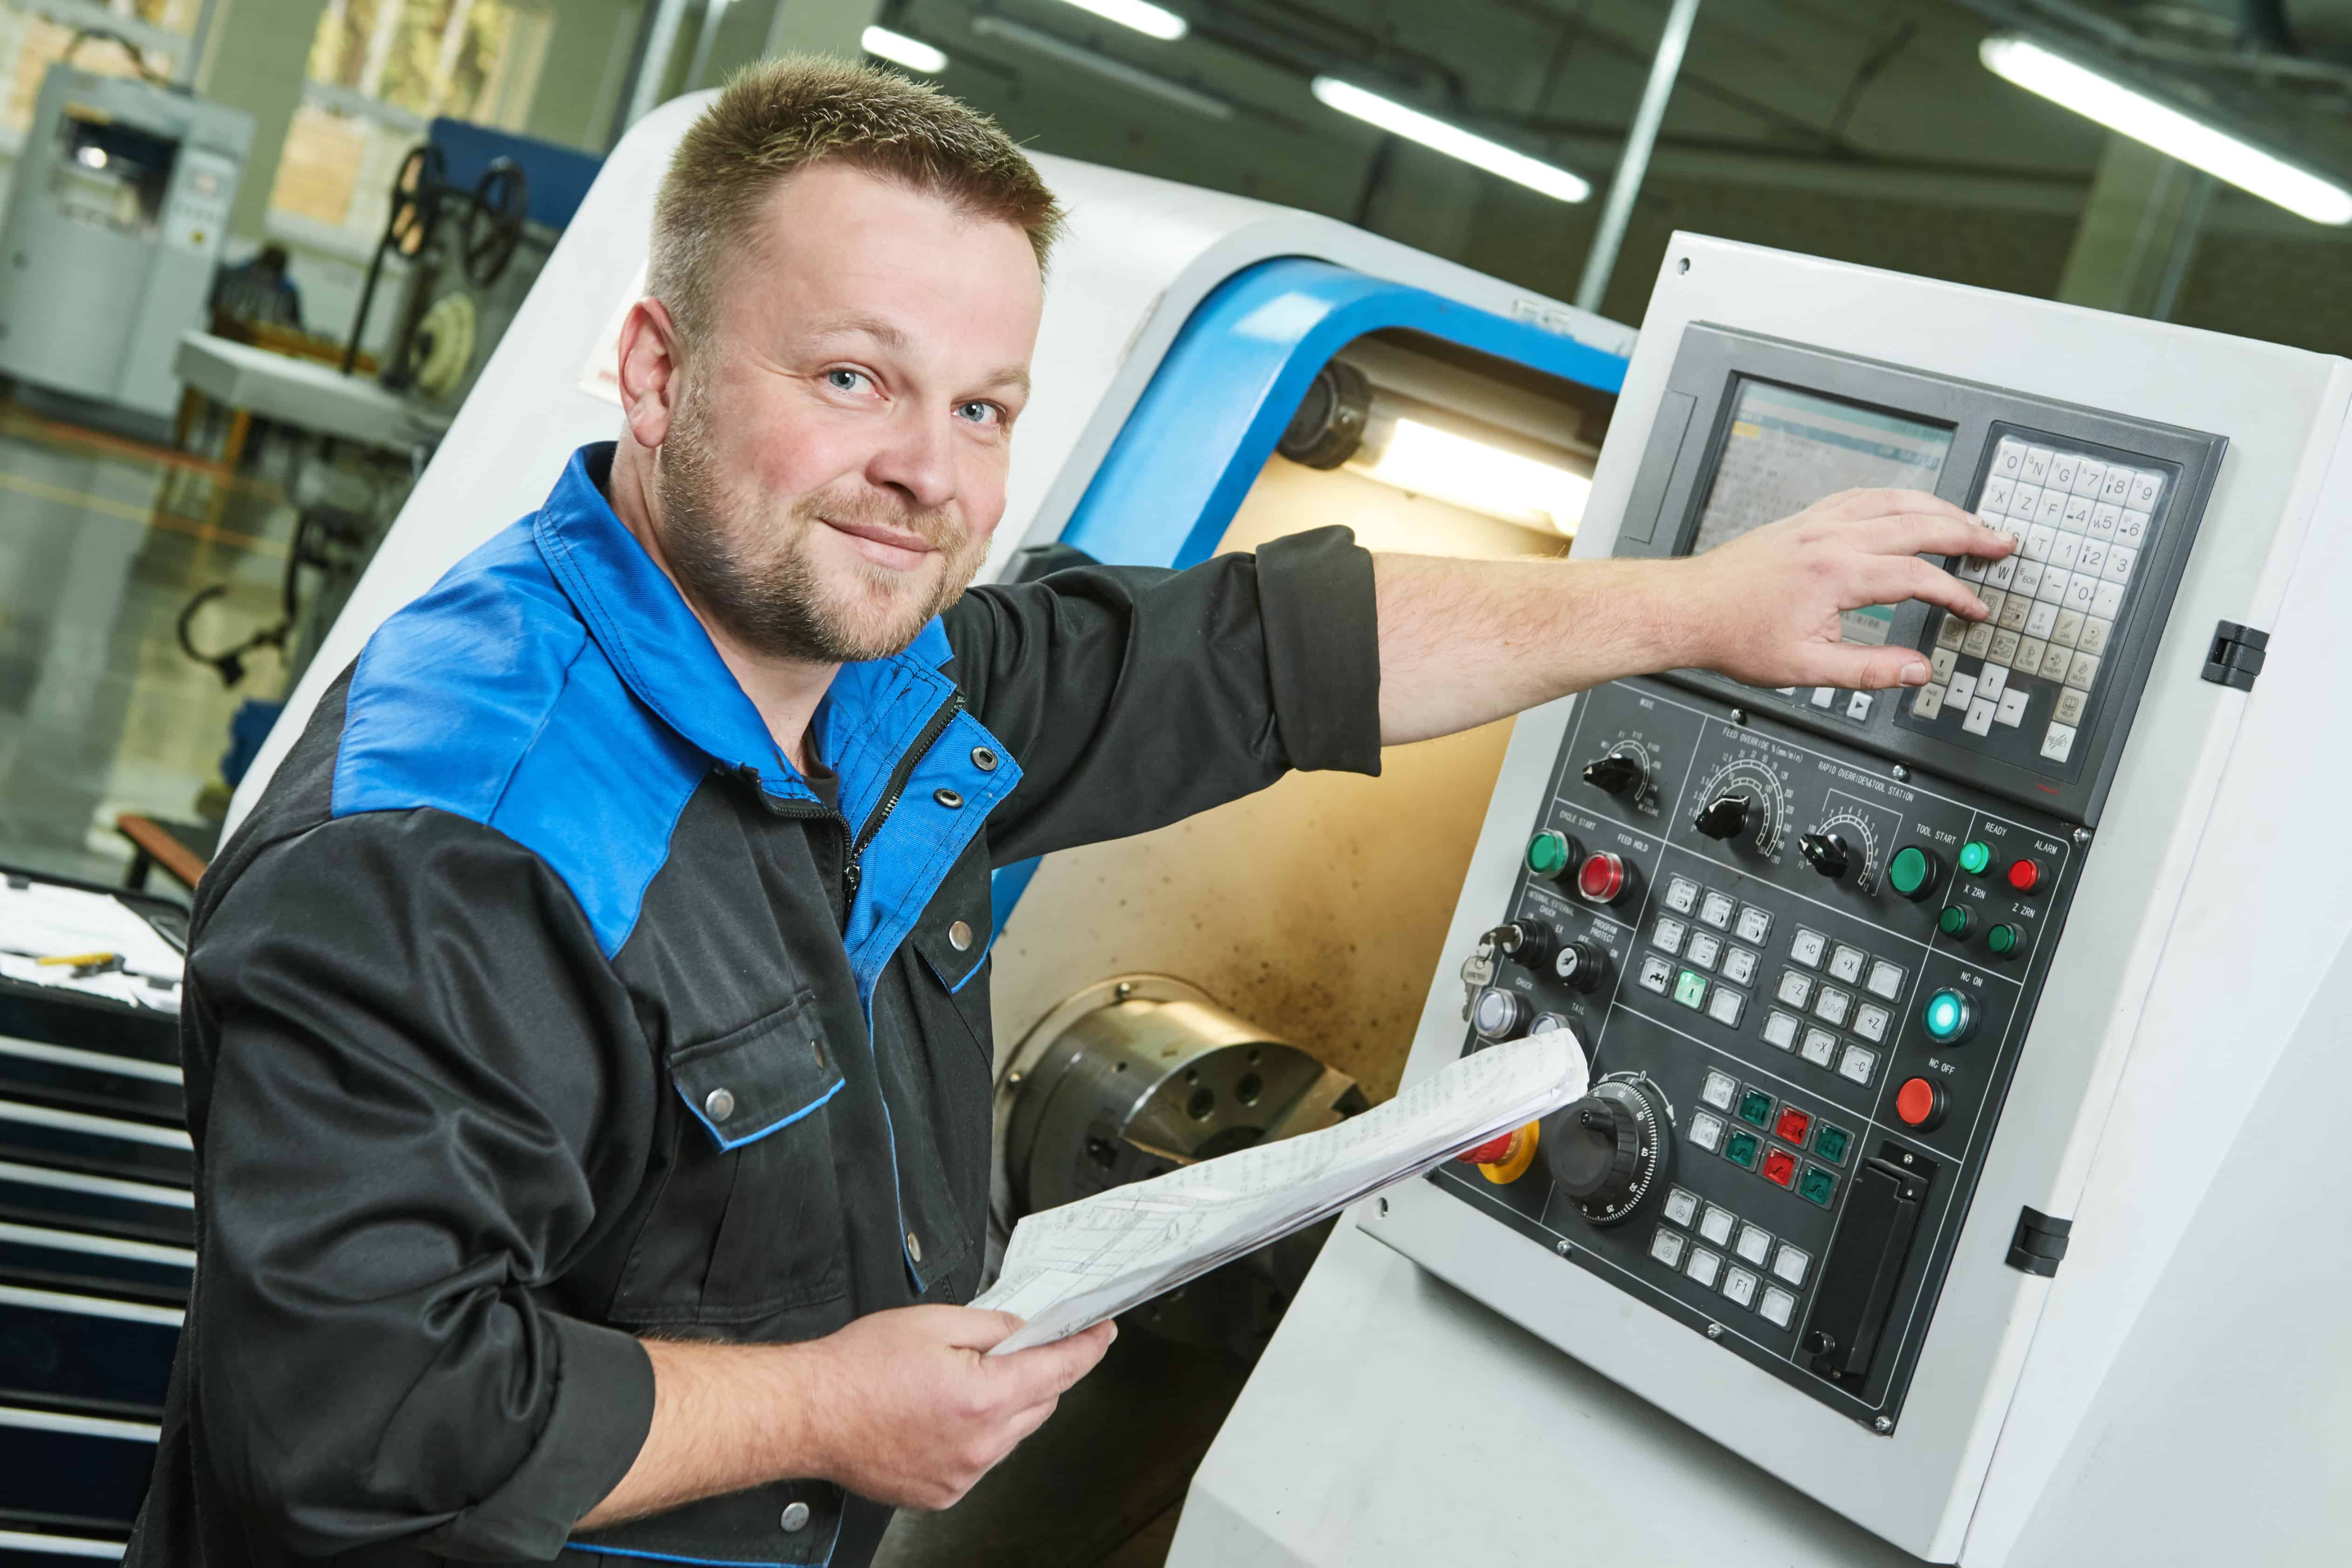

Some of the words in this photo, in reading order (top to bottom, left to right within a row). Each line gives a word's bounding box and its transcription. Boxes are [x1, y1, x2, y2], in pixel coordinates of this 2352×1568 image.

[2033, 462, 2043, 475] N
[2060, 469, 2070, 482] G
[2088, 473, 2099, 486] 7
[2114, 480, 2125, 494] 8
[2142, 487, 2152, 500] 9
[1995, 490, 2006, 503] X
[2021, 497, 2032, 510] Z
[2047, 503, 2058, 516] F
[2075, 510, 2086, 522] 4
[2102, 516, 2113, 529] 5
[2129, 523, 2140, 536] 6
[2039, 538, 2047, 551] T
[2066, 545, 2072, 557] 1
[2090, 552, 2101, 565] 2
[2117, 559, 2128, 572] 3
[1998, 566, 2010, 580] W
[2022, 576, 2037, 585] EOB
[1722, 726, 1738, 739] FEED
[1740, 733, 1769, 751] OVERRIDE
[2046, 735, 2068, 748] RESET
[1818, 760, 1836, 774] RAPID
[1888, 786, 1915, 802] STATION
[1765, 784, 1773, 794] 100
[1784, 788, 1794, 799] 200
[1829, 808, 1835, 818] 2
[1849, 806, 1853, 814] 4
[1857, 808, 1862, 817] 5
[1559, 810, 1577, 824] CYCLE
[1577, 817, 1597, 831] START
[1864, 815, 1869, 823] 6
[1782, 823, 1792, 834] 500
[1807, 823, 1816, 834] 100
[1870, 823, 1876, 831] 7
[1985, 822, 2008, 837] READY
[1874, 835, 1878, 843] 8
[1916, 823, 1932, 837] TOOL
[1935, 831, 1957, 845] START
[1617, 833, 1633, 846] FEED
[1633, 839, 1649, 853] HOLD
[2034, 840, 2058, 855] ALARM
[1874, 848, 1879, 857] 9
[1871, 861, 1878, 870] 10
[1964, 884, 1971, 894] X
[1971, 888, 1986, 900] ZRN
[2012, 903, 2019, 912] Z
[2020, 906, 2036, 919] ZRN
[1555, 923, 1564, 934] EX
[1592, 917, 1618, 935] PROGRAM
[1590, 926, 1615, 944] PROTECT
[1610, 948, 1618, 959] ON
[1805, 944, 1816, 955] +C
[1843, 959, 1856, 972] +X
[1960, 971, 1972, 983] NC
[1972, 976, 1984, 987] ON
[1792, 984, 1804, 996] -Z
[1571, 1002, 1585, 1016] TAIL
[1868, 1016, 1880, 1030] +Z
[1815, 1041, 1828, 1054] -X
[1854, 1061, 1866, 1072] -C
[1929, 1058, 1939, 1069] NC
[1940, 1062, 1956, 1076] OFF
[1639, 1070, 1647, 1081] 0
[1641, 1147, 1649, 1157] 40
[1735, 1278, 1748, 1295] F1
